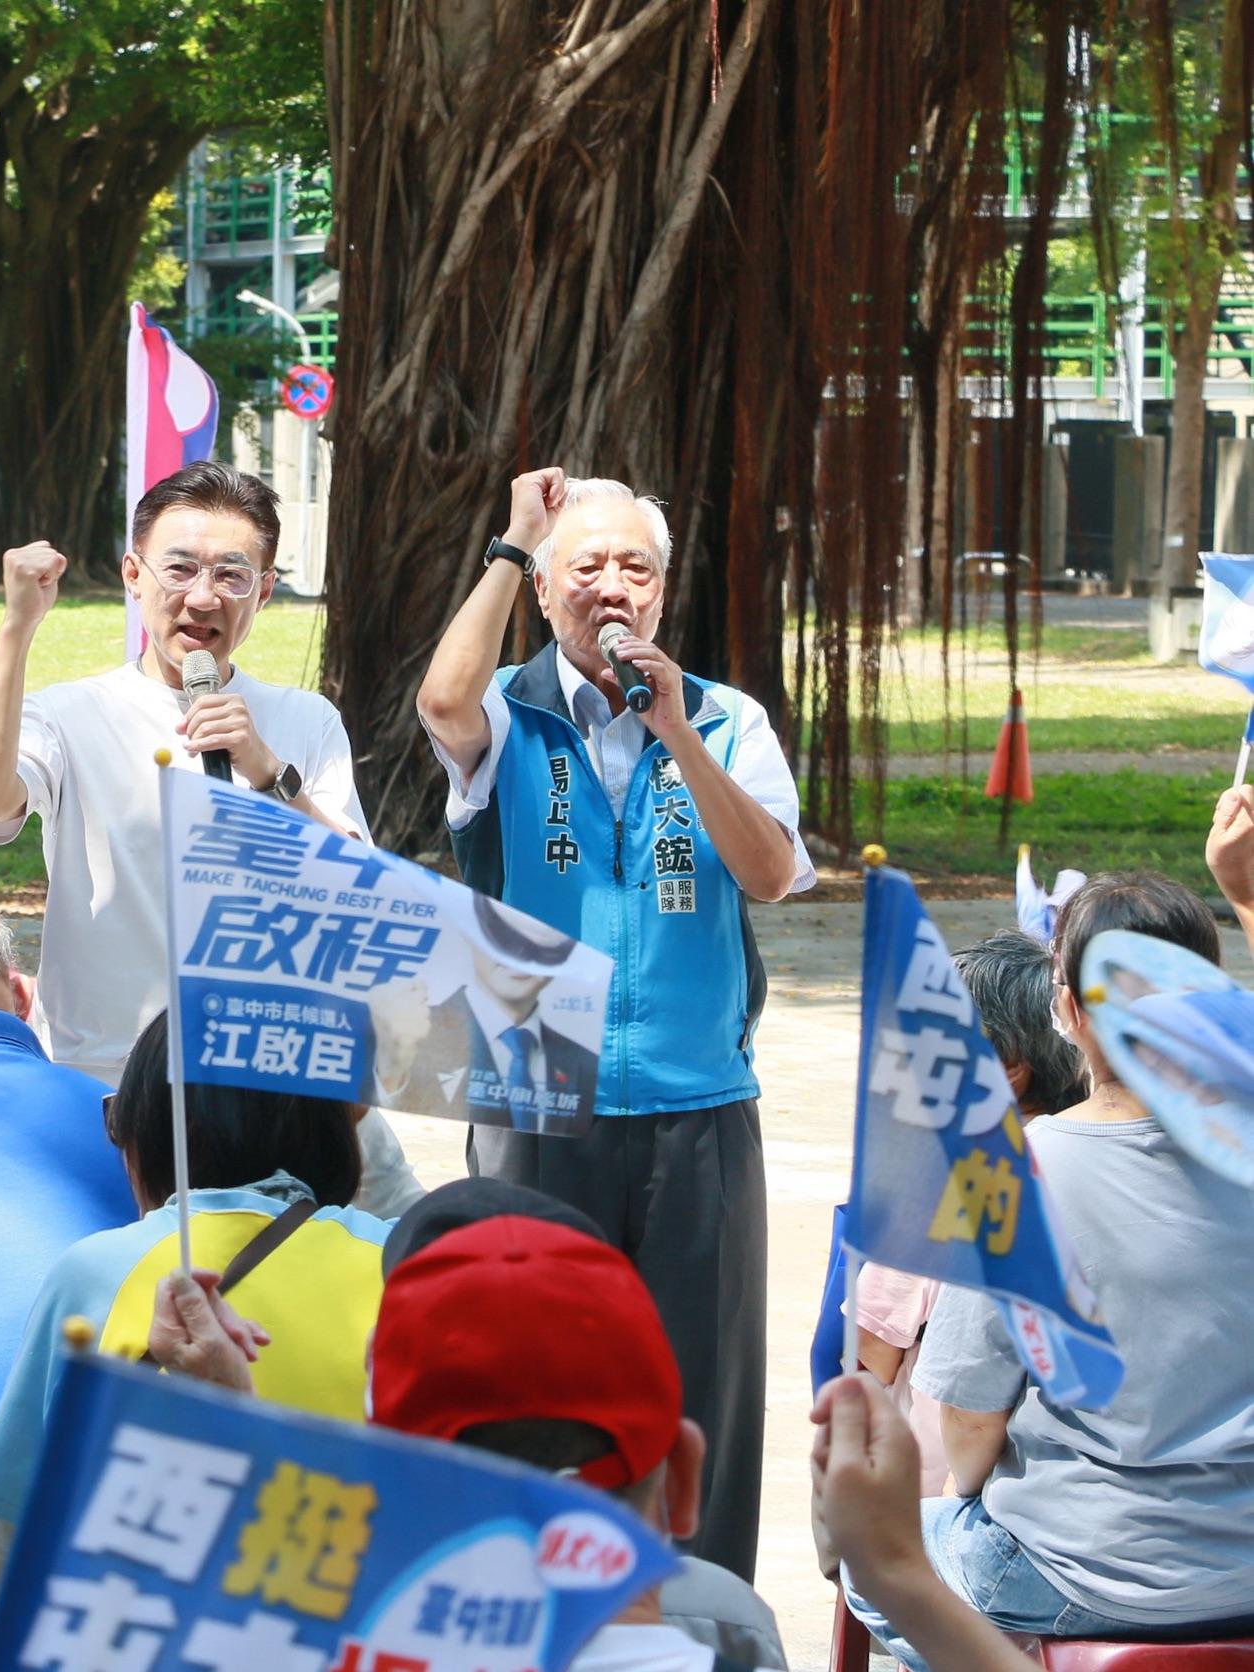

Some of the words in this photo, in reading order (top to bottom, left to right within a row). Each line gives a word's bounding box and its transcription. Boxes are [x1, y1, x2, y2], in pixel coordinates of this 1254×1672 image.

[649, 756, 696, 877] 楊大鋐
[183, 869, 235, 886] MAKE
[243, 876, 329, 902] TAICHUNG
[335, 892, 384, 911] BEST
[390, 901, 438, 919] EVER
[182, 895, 442, 993] 啟程
[226, 997, 352, 1031] 臺中市長候選人
[199, 1019, 356, 1083] 江啟臣
